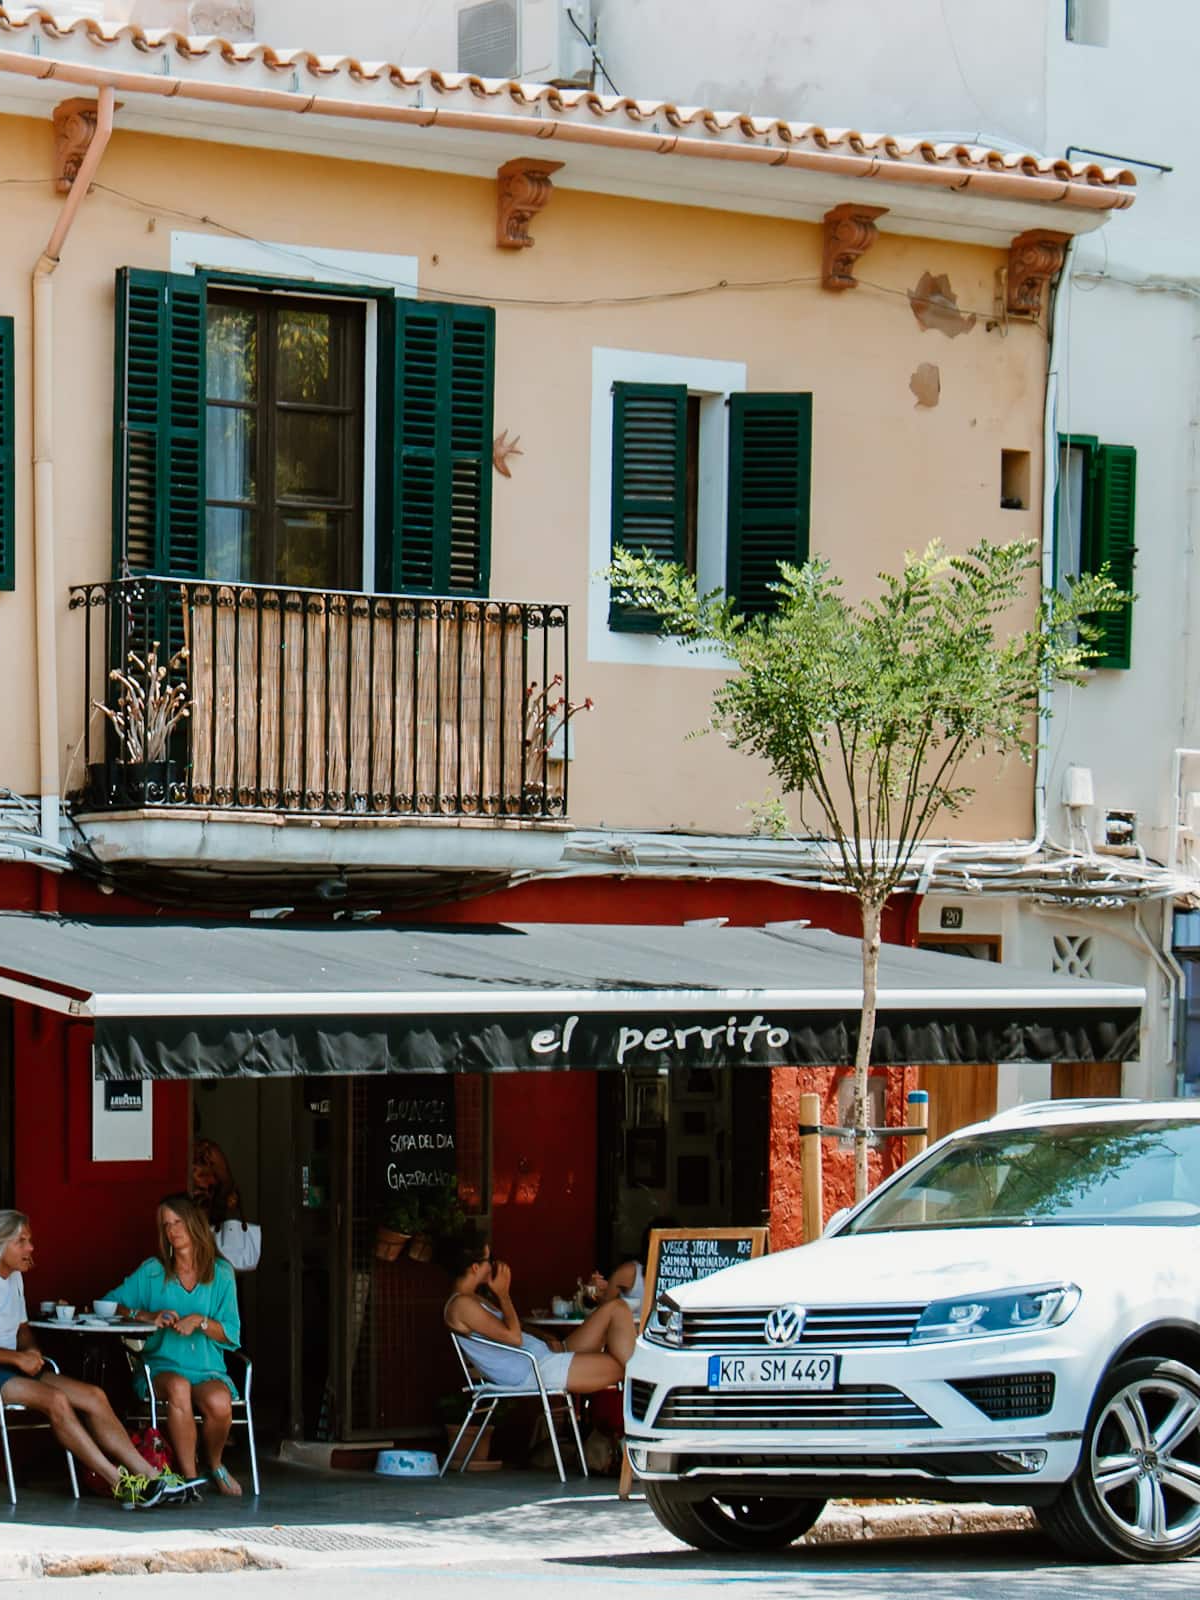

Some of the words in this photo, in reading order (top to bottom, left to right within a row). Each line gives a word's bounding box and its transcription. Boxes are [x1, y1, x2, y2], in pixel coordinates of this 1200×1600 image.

[946, 911, 960, 925] 20
[531, 1016, 579, 1053] el
[617, 1016, 789, 1064] perrito
[110, 1093, 142, 1104] LAVAZZA
[390, 1134, 417, 1153] SOPA
[418, 1133, 435, 1149] DEL
[662, 1240, 689, 1255] VEGGIE
[690, 1239, 719, 1256] SPECIAL
[737, 1241, 752, 1254] 10€
[692, 1256, 730, 1269] MARINADO
[720, 1360, 745, 1382] KR
[760, 1359, 786, 1381] SM
[791, 1359, 831, 1381] 449
